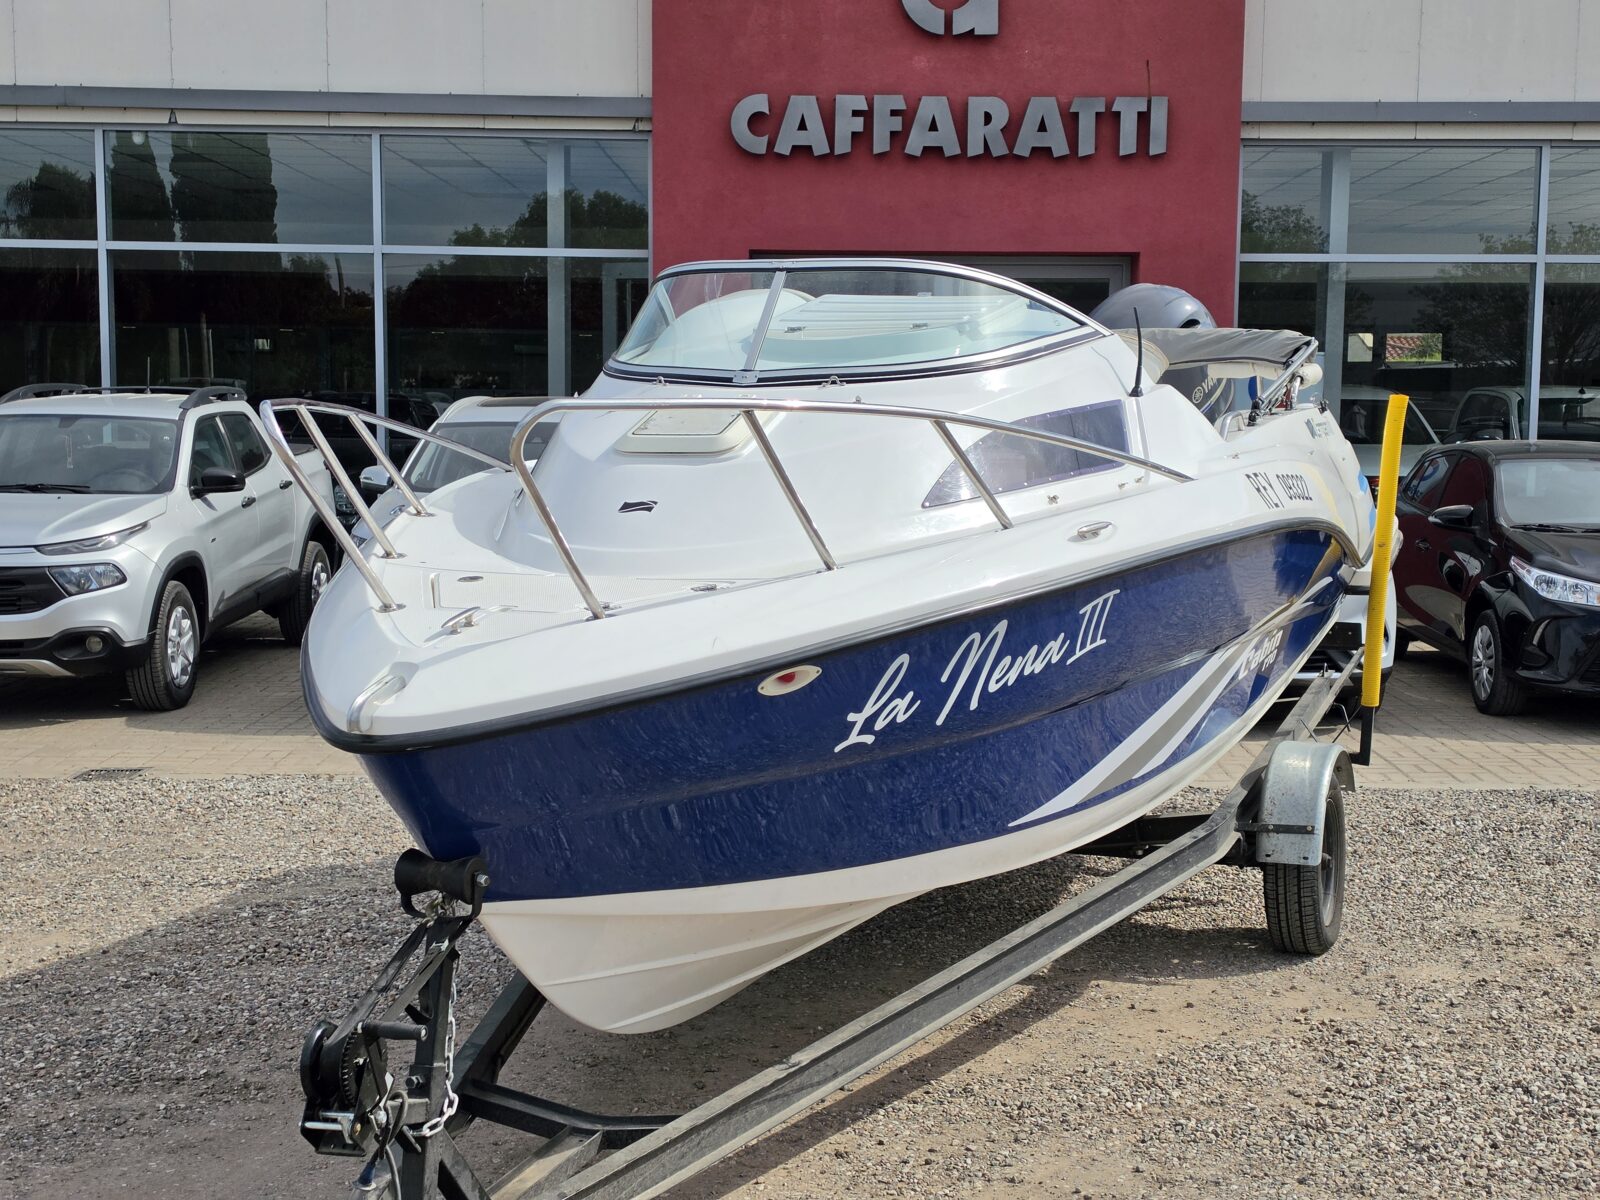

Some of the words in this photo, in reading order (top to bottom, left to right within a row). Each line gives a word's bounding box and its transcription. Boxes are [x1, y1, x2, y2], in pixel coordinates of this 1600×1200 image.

[730, 93, 1169, 158] CAFFARATTI
[1245, 472, 1285, 510] REY
[834, 653, 921, 753] La
[935, 619, 1070, 726] Nena
[1066, 589, 1121, 665] III
